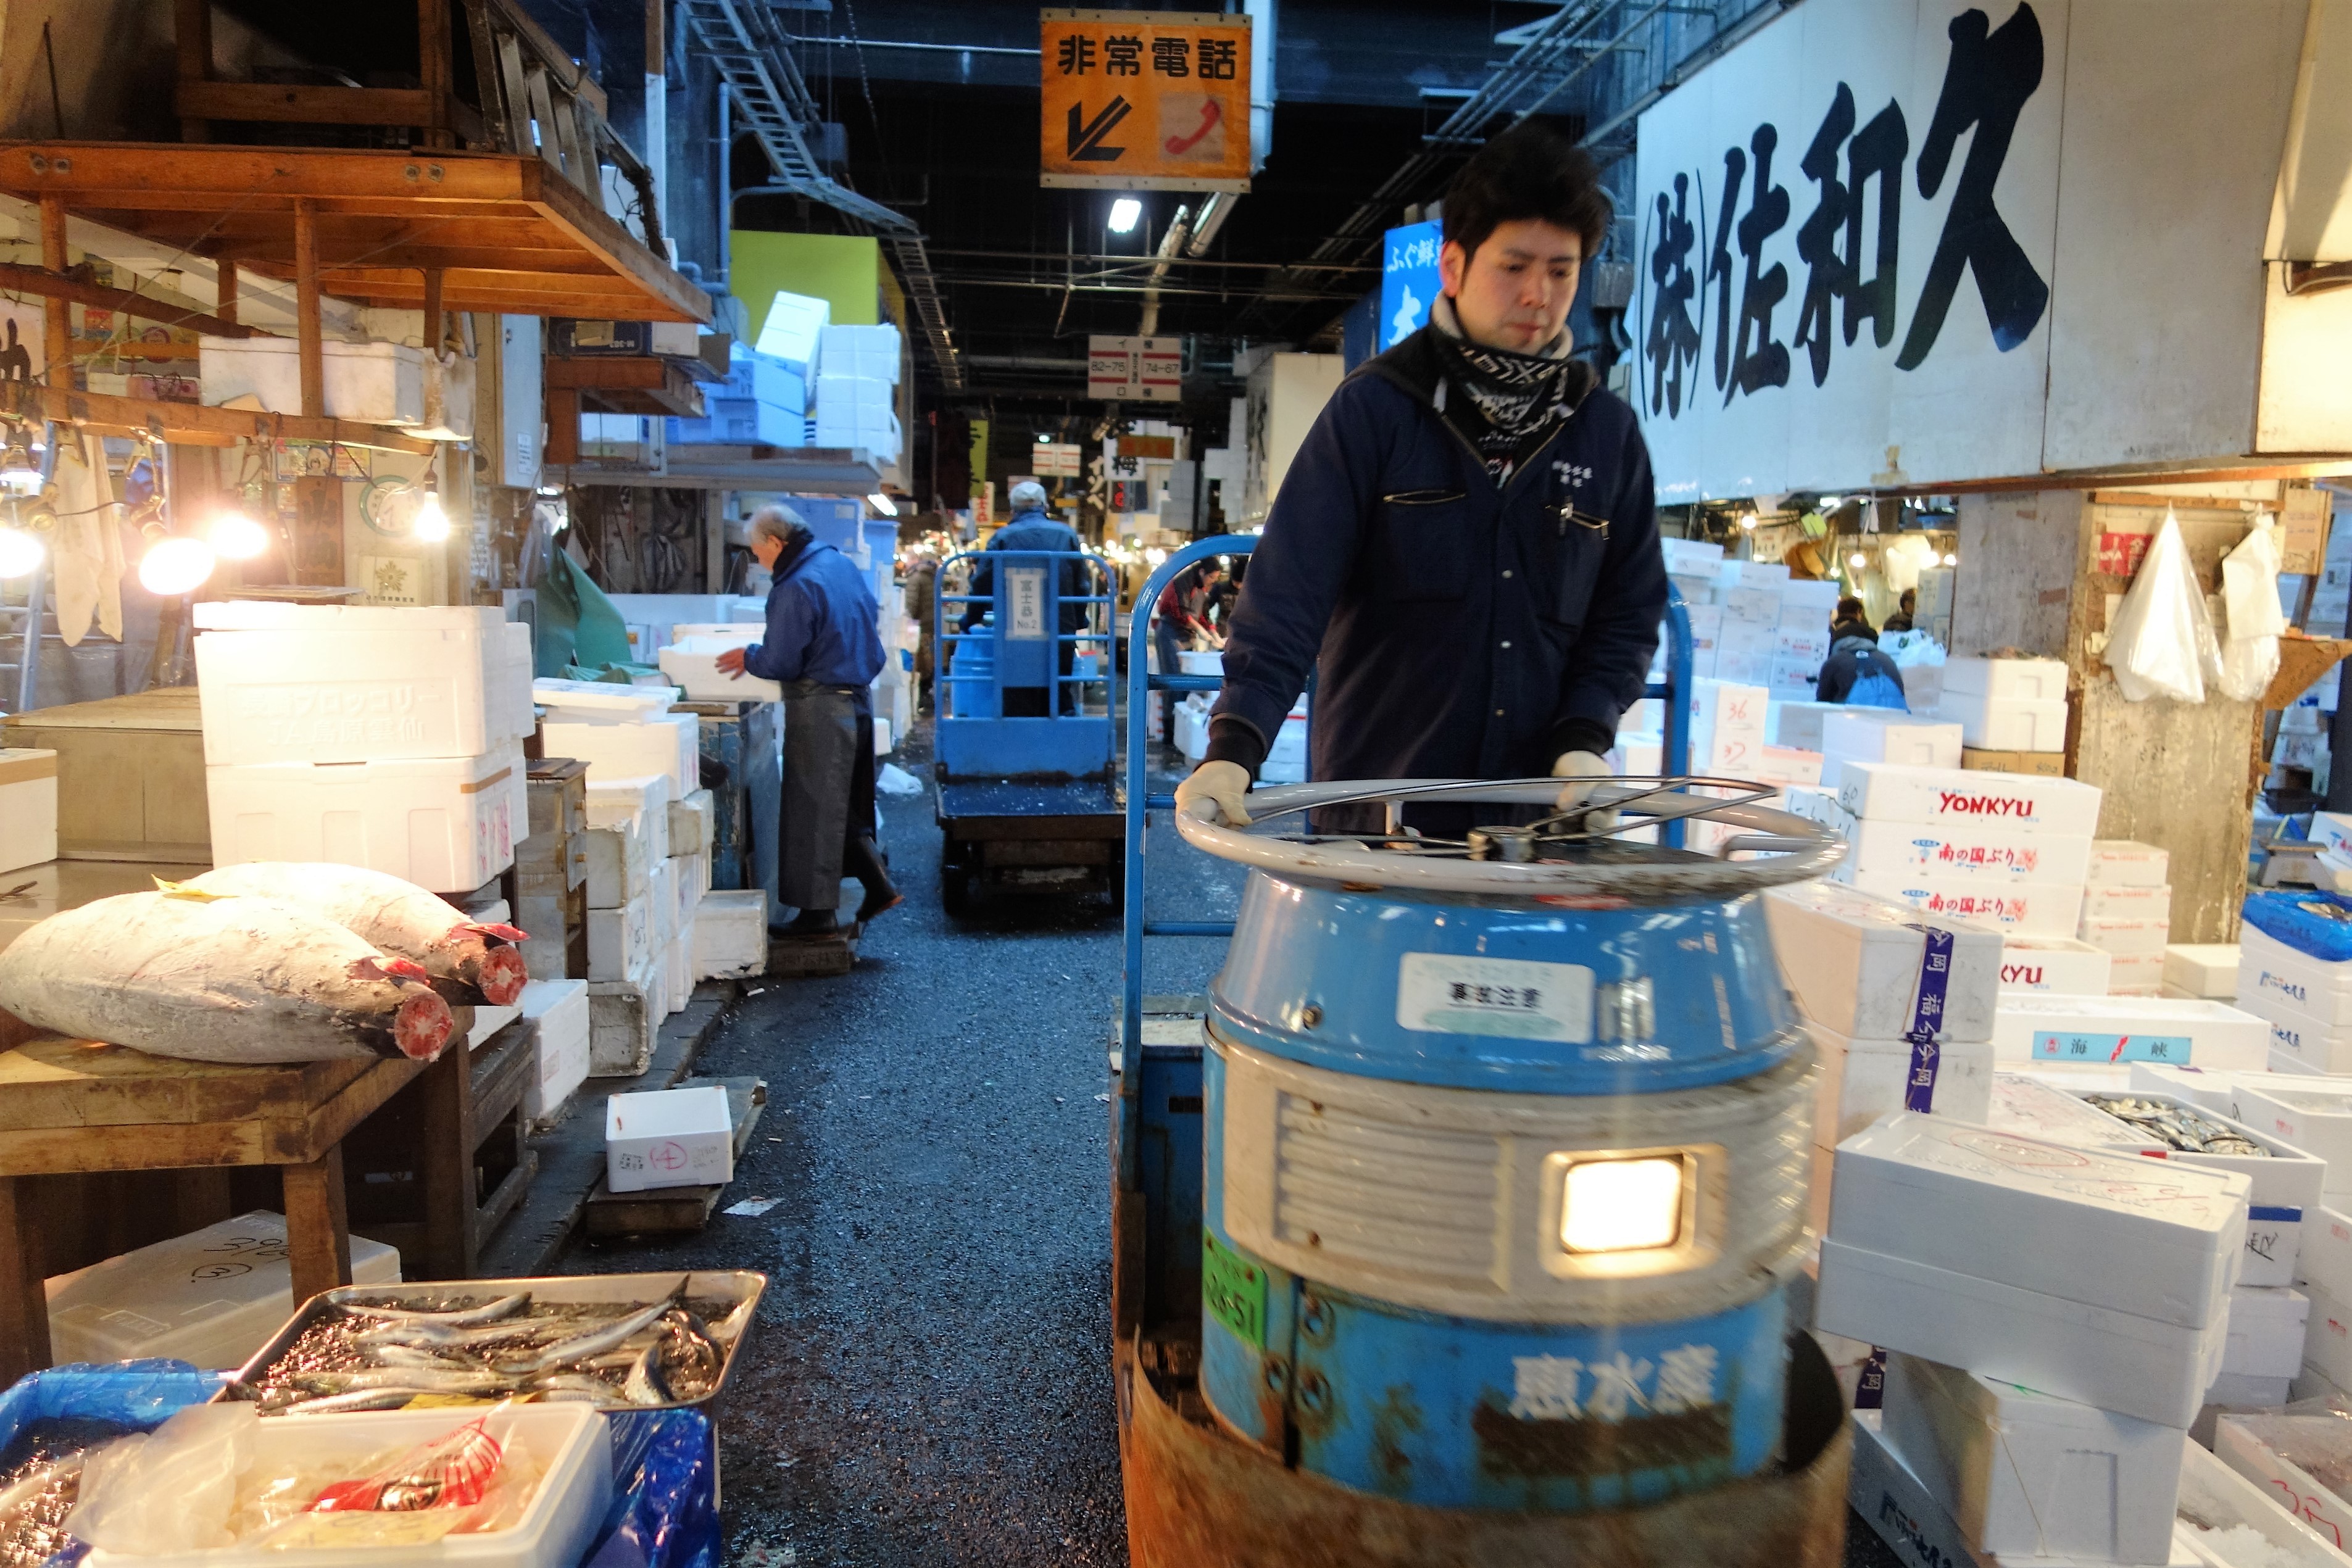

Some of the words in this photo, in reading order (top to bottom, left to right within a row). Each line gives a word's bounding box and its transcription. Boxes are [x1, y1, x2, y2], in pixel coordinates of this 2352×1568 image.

[1058, 35, 1236, 80] 非常電話
[1727, 699, 1748, 721] 36
[1940, 792, 2033, 817] YONKYU
[1939, 842, 2014, 867] 南の国ぶり
[1929, 892, 2003, 916] 南の国ぶり
[1450, 982, 1544, 1008] 事故注意
